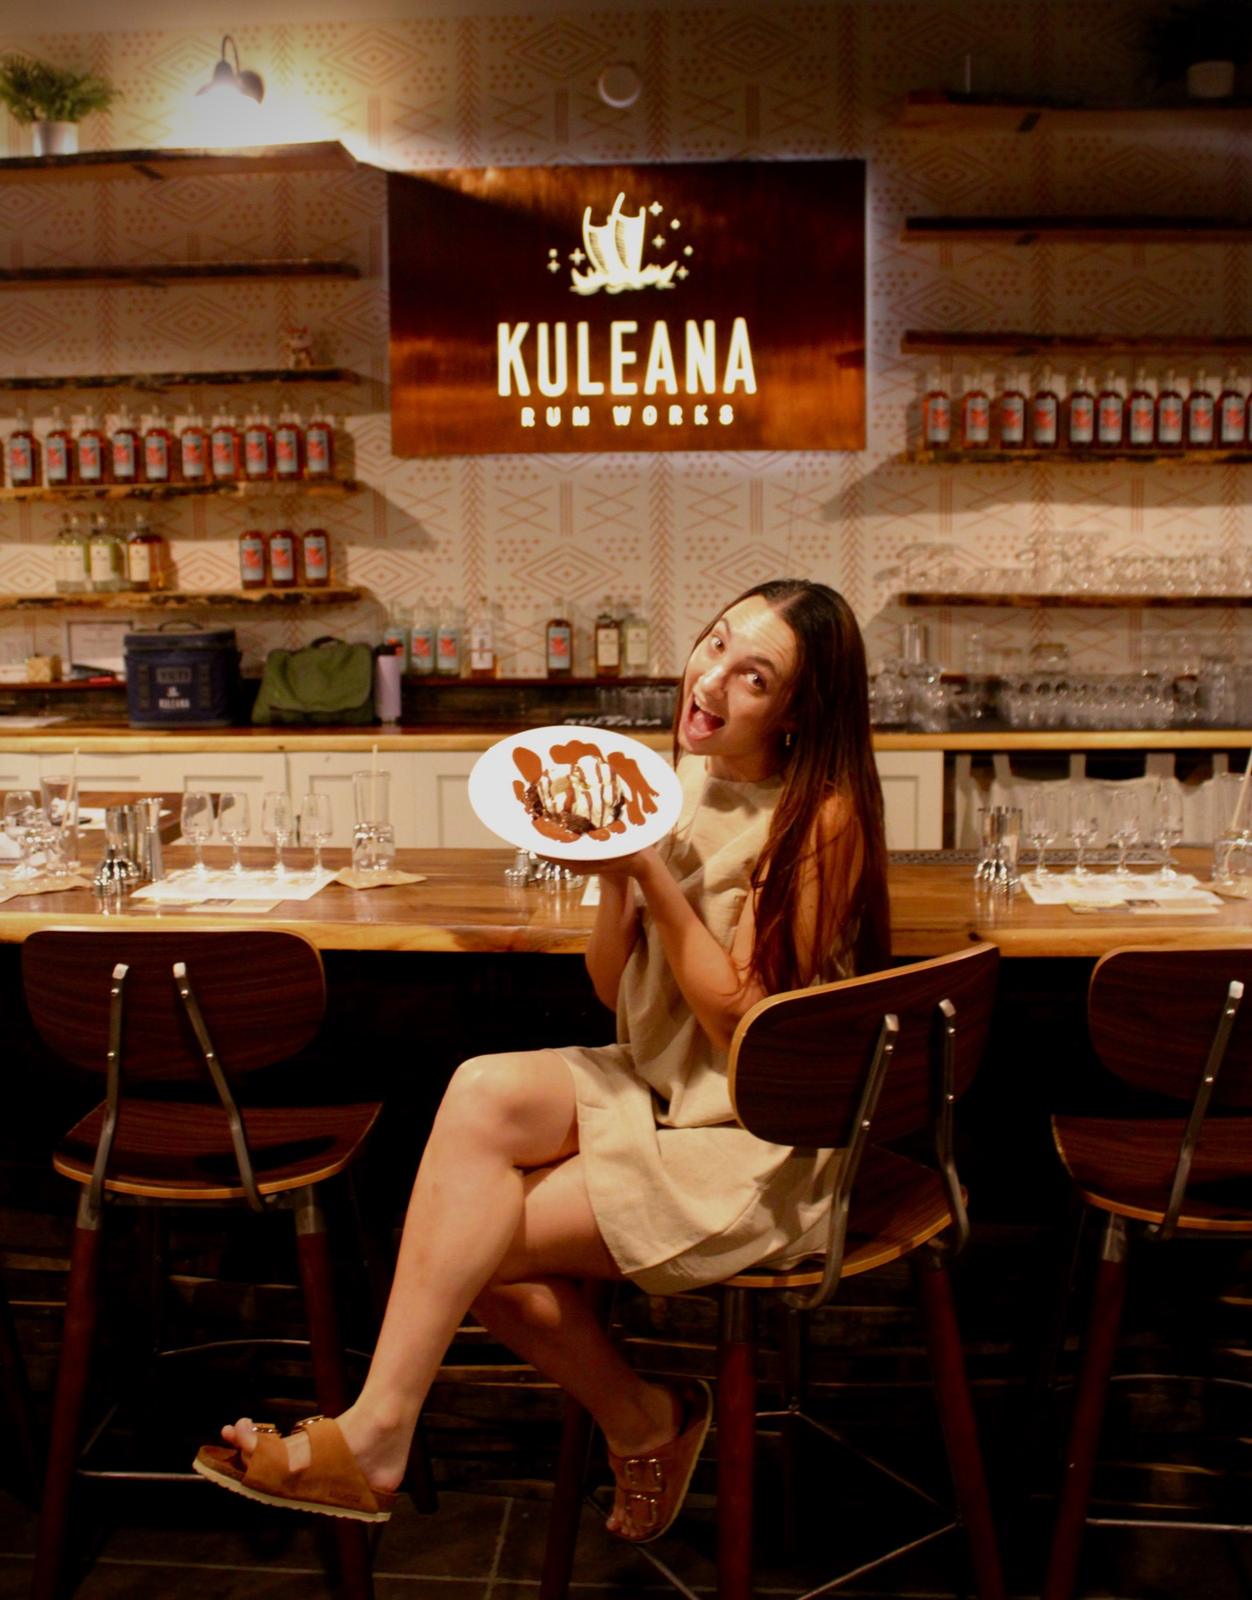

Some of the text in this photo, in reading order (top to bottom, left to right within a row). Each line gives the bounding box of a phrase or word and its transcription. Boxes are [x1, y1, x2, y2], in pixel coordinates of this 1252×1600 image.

[497, 317, 757, 397] KULEANA
[520, 404, 734, 427] RUM WORKS
